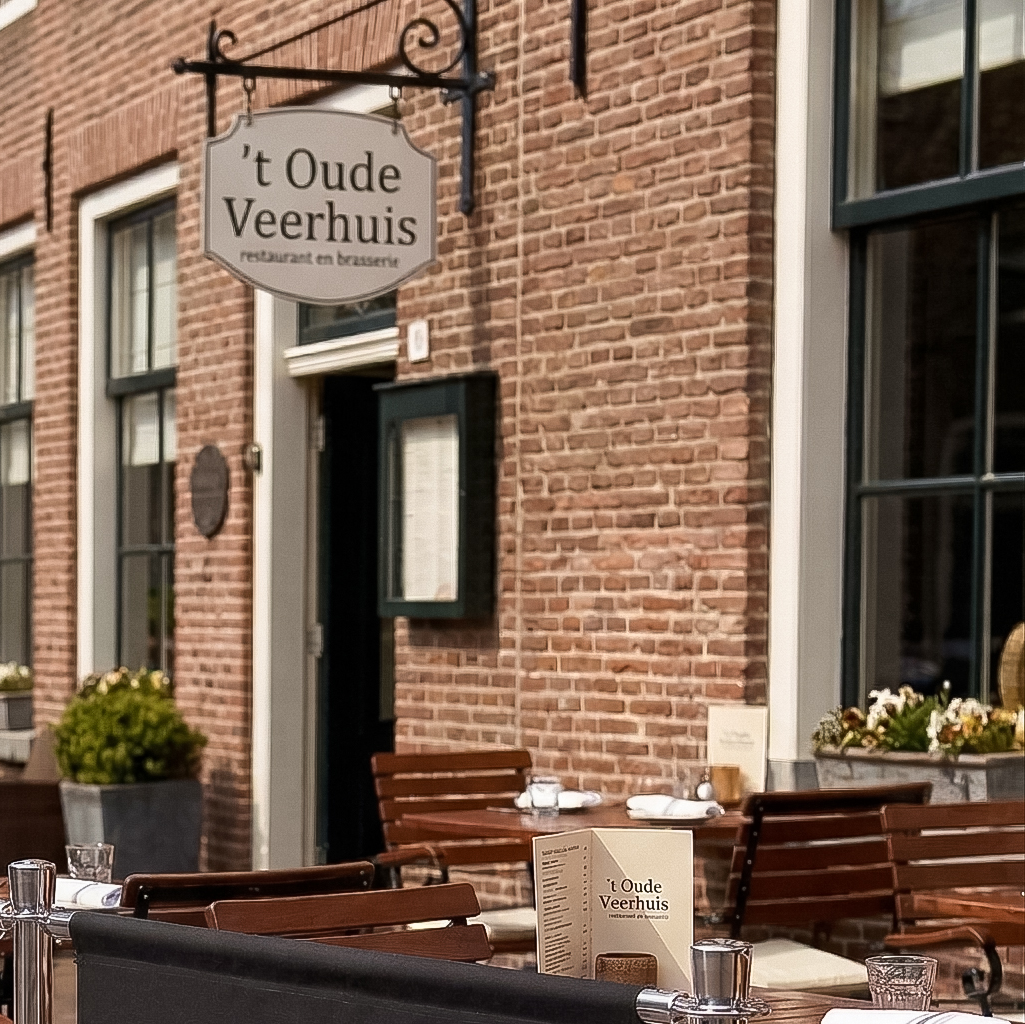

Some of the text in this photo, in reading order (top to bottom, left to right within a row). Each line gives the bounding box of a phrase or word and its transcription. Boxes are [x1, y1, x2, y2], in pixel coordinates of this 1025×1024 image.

[241, 143, 402, 193] ’t Oude
[223, 196, 418, 246] Veerhuis
[240, 249, 399, 268] restaurant en brasserie
[606, 878, 663, 893] 't Oude
[599, 895, 669, 911] Veerhuis
